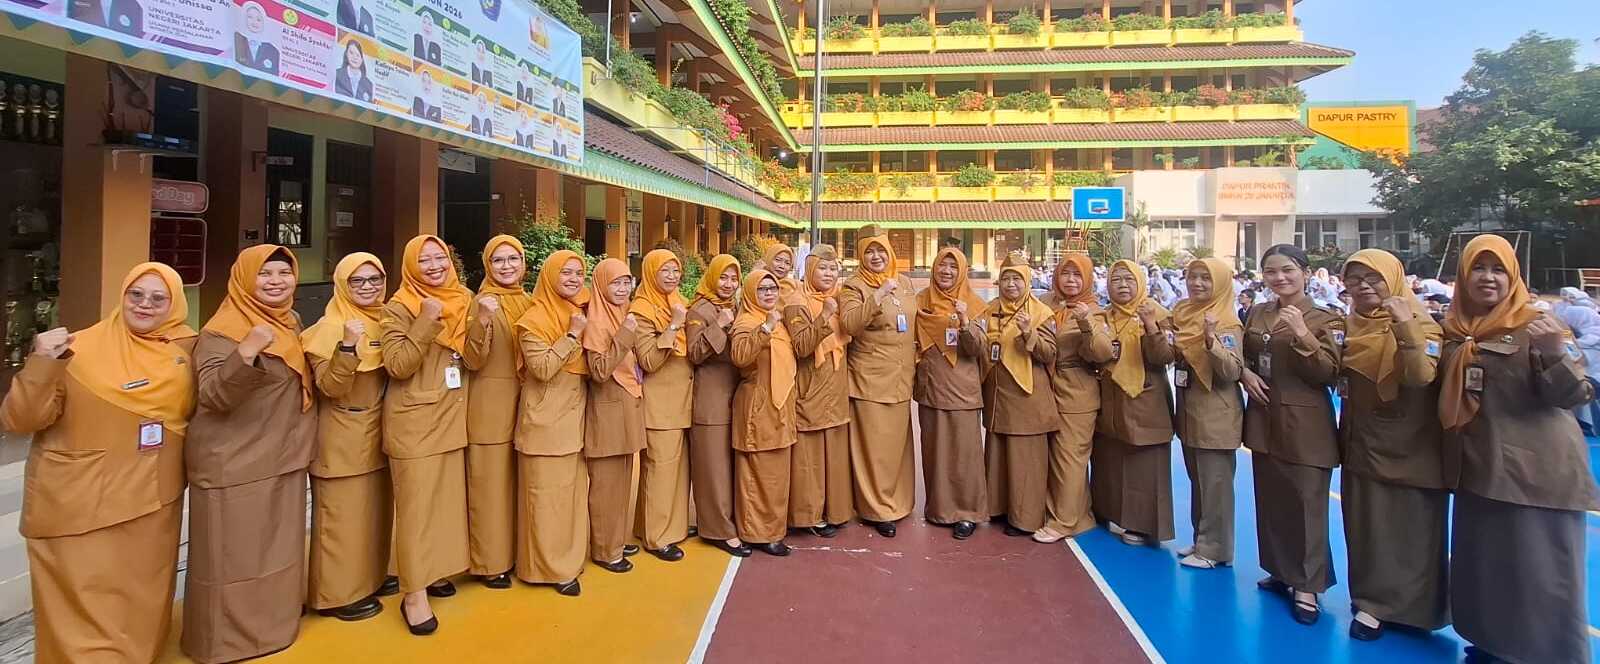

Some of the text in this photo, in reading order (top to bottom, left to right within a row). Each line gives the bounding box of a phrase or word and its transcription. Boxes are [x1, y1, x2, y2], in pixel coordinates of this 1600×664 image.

[148, 6, 205, 26] UNIVERSITAS
[444, 3, 463, 19] 2026
[148, 13, 180, 25] NEGERI
[183, 22, 222, 35] JAKARTA
[1318, 112, 1398, 122] DAPUR PASTRY
